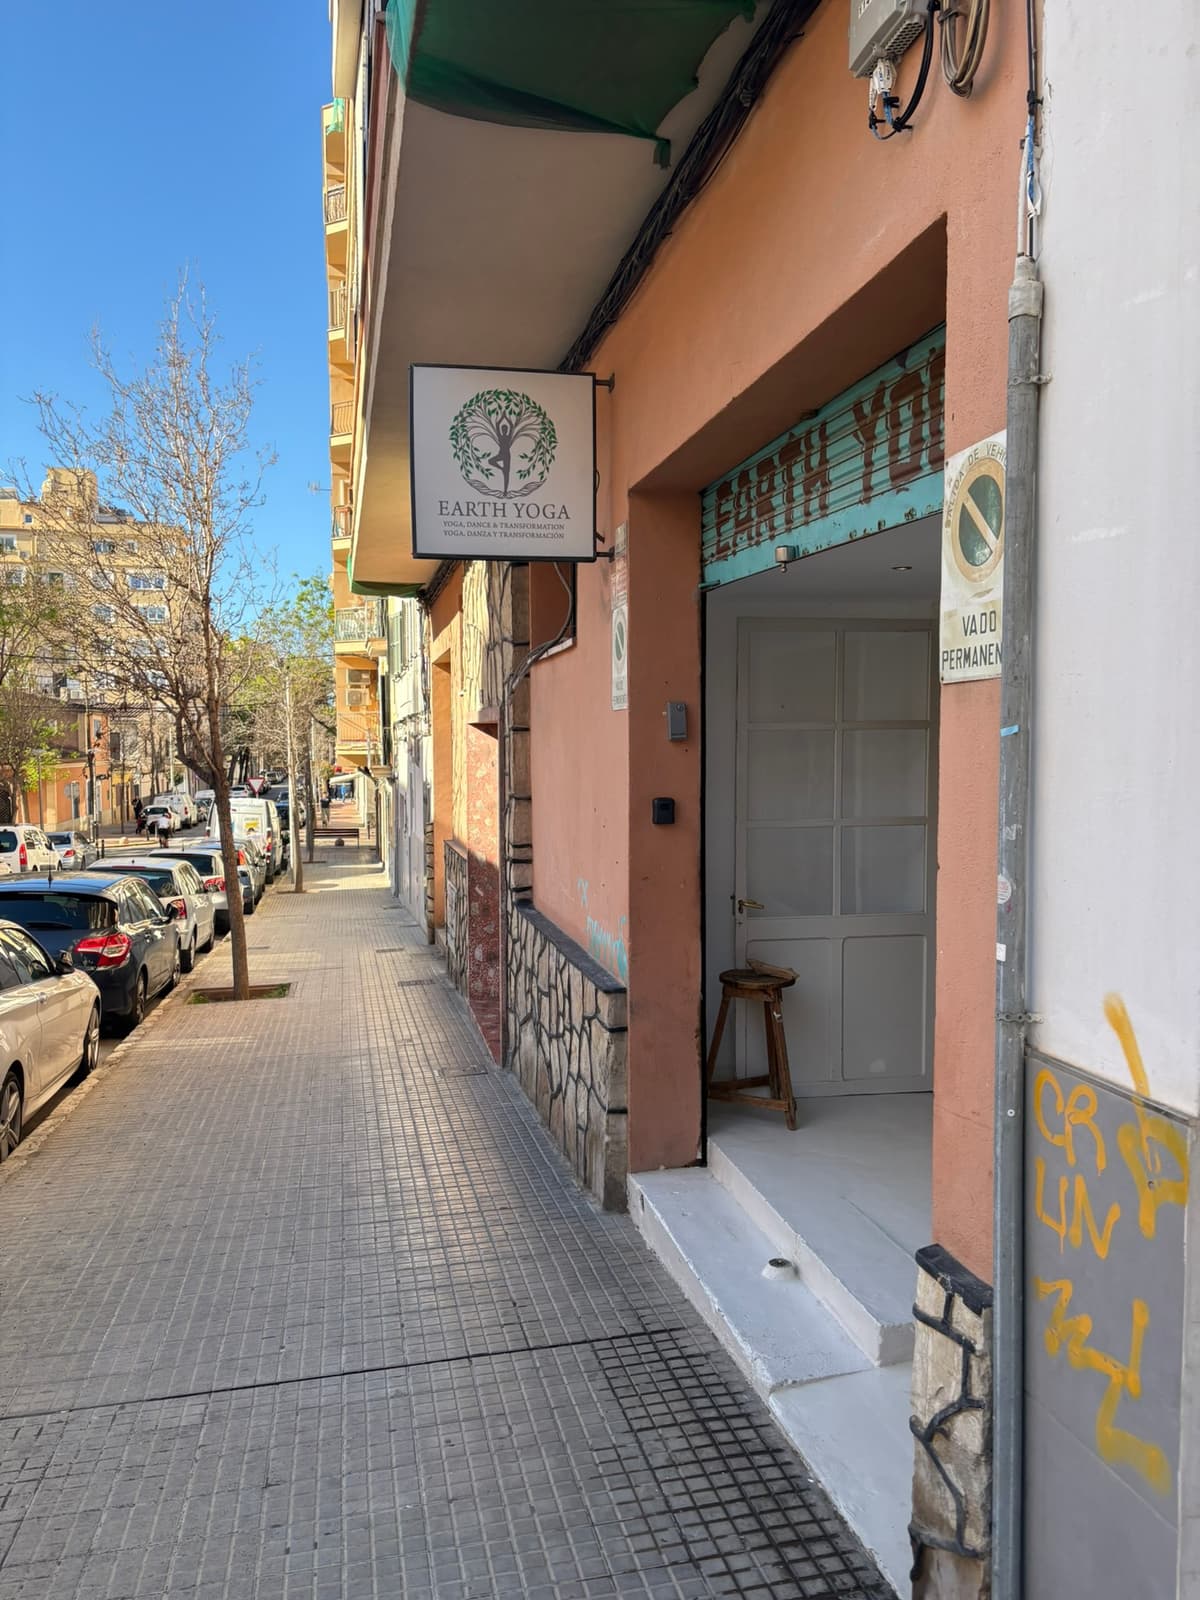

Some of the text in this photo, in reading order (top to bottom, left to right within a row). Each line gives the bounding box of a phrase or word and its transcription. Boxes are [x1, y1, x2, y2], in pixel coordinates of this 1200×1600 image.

[968, 447, 980, 467] DE
[438, 500, 571, 520] EARTH YOGA
[466, 521, 491, 529] DANCE
[500, 521, 565, 531] TRANSFORMATION
[962, 610, 997, 637] VADO
[942, 642, 1003, 671] PERMANEN
